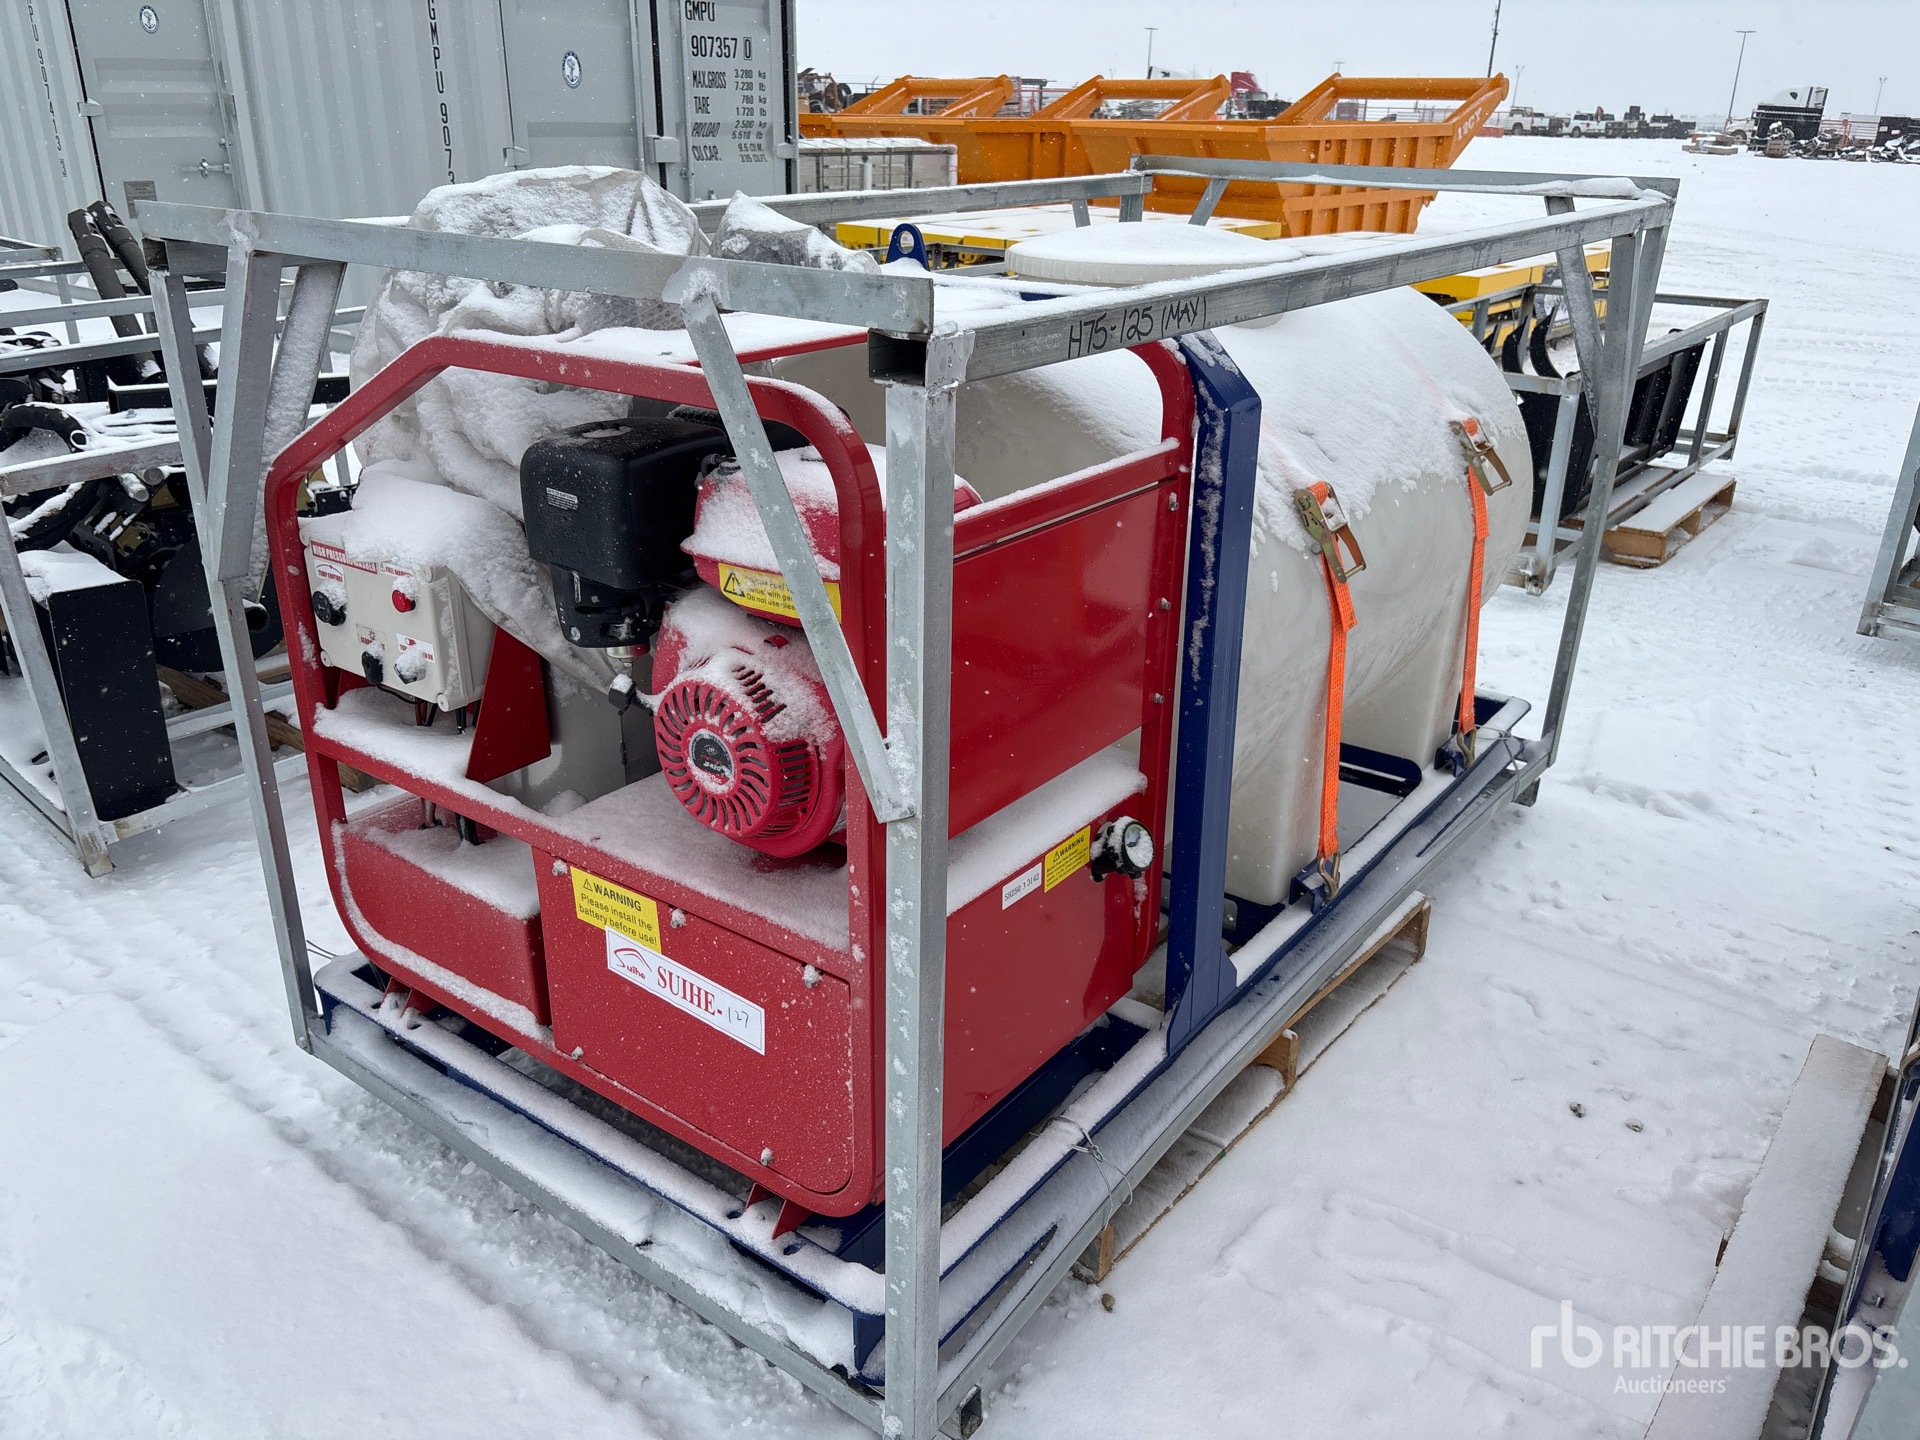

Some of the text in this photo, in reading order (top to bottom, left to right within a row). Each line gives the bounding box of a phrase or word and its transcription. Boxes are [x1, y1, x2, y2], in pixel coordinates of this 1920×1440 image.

[685, 1, 716, 22] GMPU
[428, 0, 445, 93] GMPU
[691, 35, 738, 59] 907357
[26, 0, 39, 41] PU
[37, 48, 63, 151] 907413
[734, 81, 767, 91] 7.230 lb
[758, 70, 767, 79] kg
[693, 96, 710, 114] TARE
[758, 95, 767, 104] kg
[736, 107, 767, 116] 1.720 lb
[691, 122, 721, 137] PAYLOAD
[1067, 304, 1154, 359] H75-125
[746, 593, 756, 601] Do
[1059, 834, 1085, 857] WARNING
[593, 882, 642, 912] WARNING
[581, 893, 652, 931] Please install the
[579, 904, 657, 946] battery before use!
